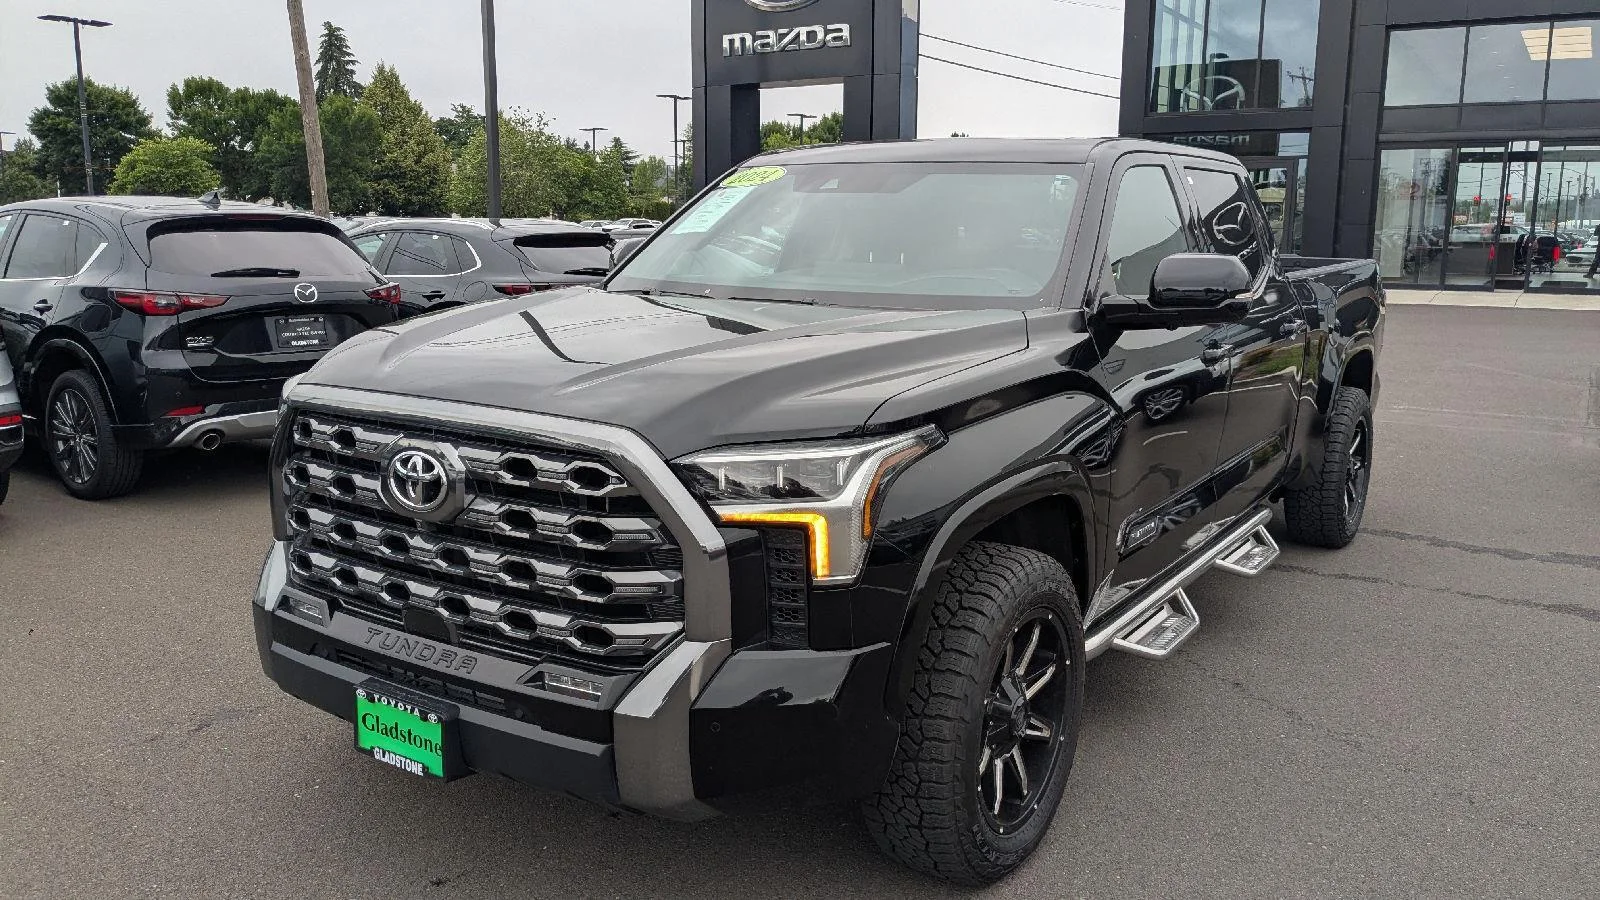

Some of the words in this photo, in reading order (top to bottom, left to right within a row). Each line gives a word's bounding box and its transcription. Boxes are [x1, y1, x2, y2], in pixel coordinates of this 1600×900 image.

[364, 626, 478, 675] TUNDRA
[374, 694, 421, 717] TOYOTA
[361, 712, 443, 757] Gladstone
[373, 747, 424, 777] GLADSTONE
